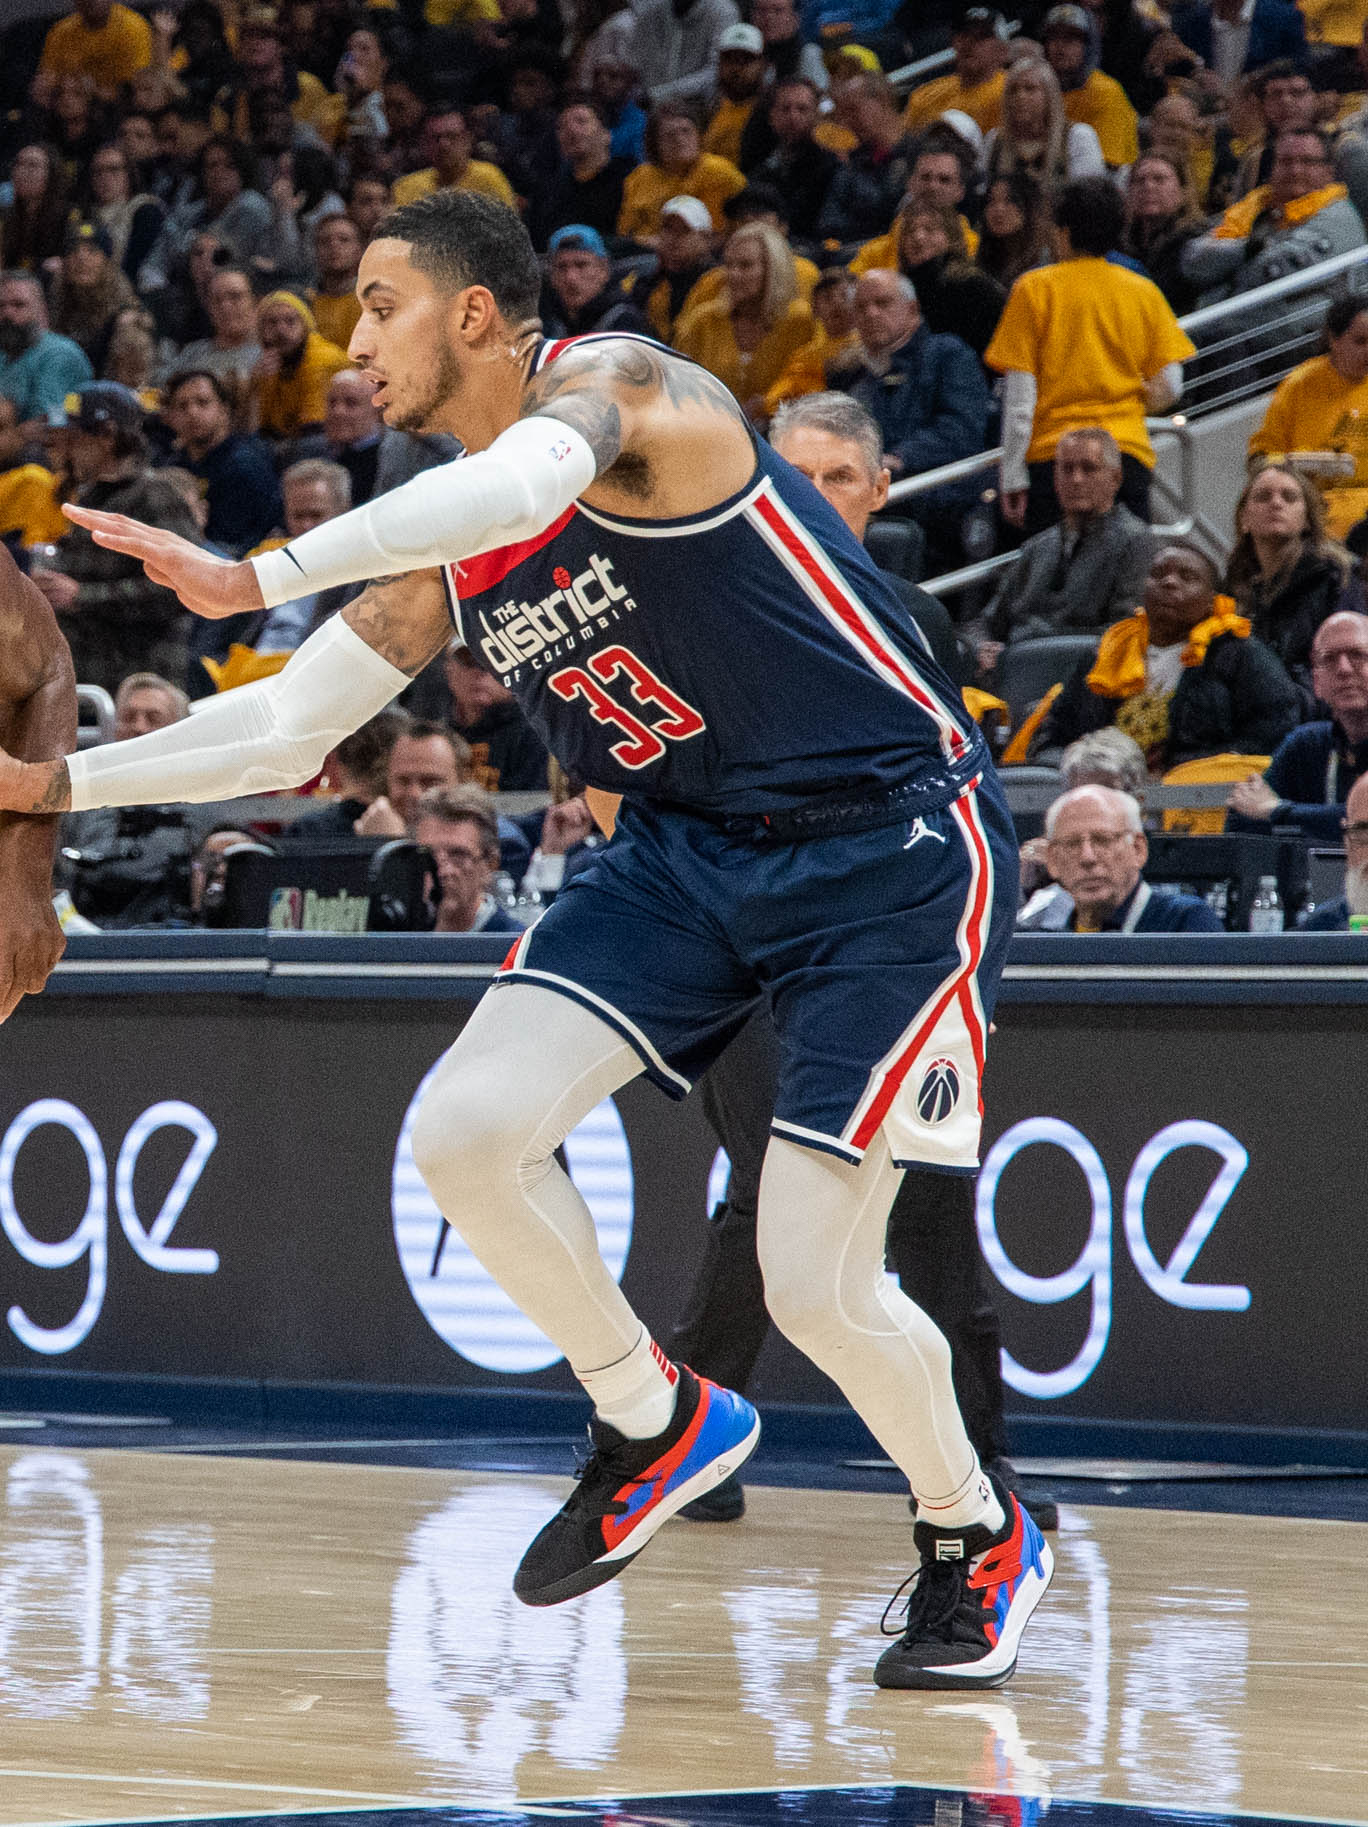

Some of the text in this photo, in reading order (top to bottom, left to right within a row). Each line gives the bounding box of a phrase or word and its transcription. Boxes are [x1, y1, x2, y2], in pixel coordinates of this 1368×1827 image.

[478, 553, 628, 674] district
[492, 599, 520, 624] THE
[503, 598, 637, 688] OF COLUMBIA
[547, 644, 706, 770] 33
